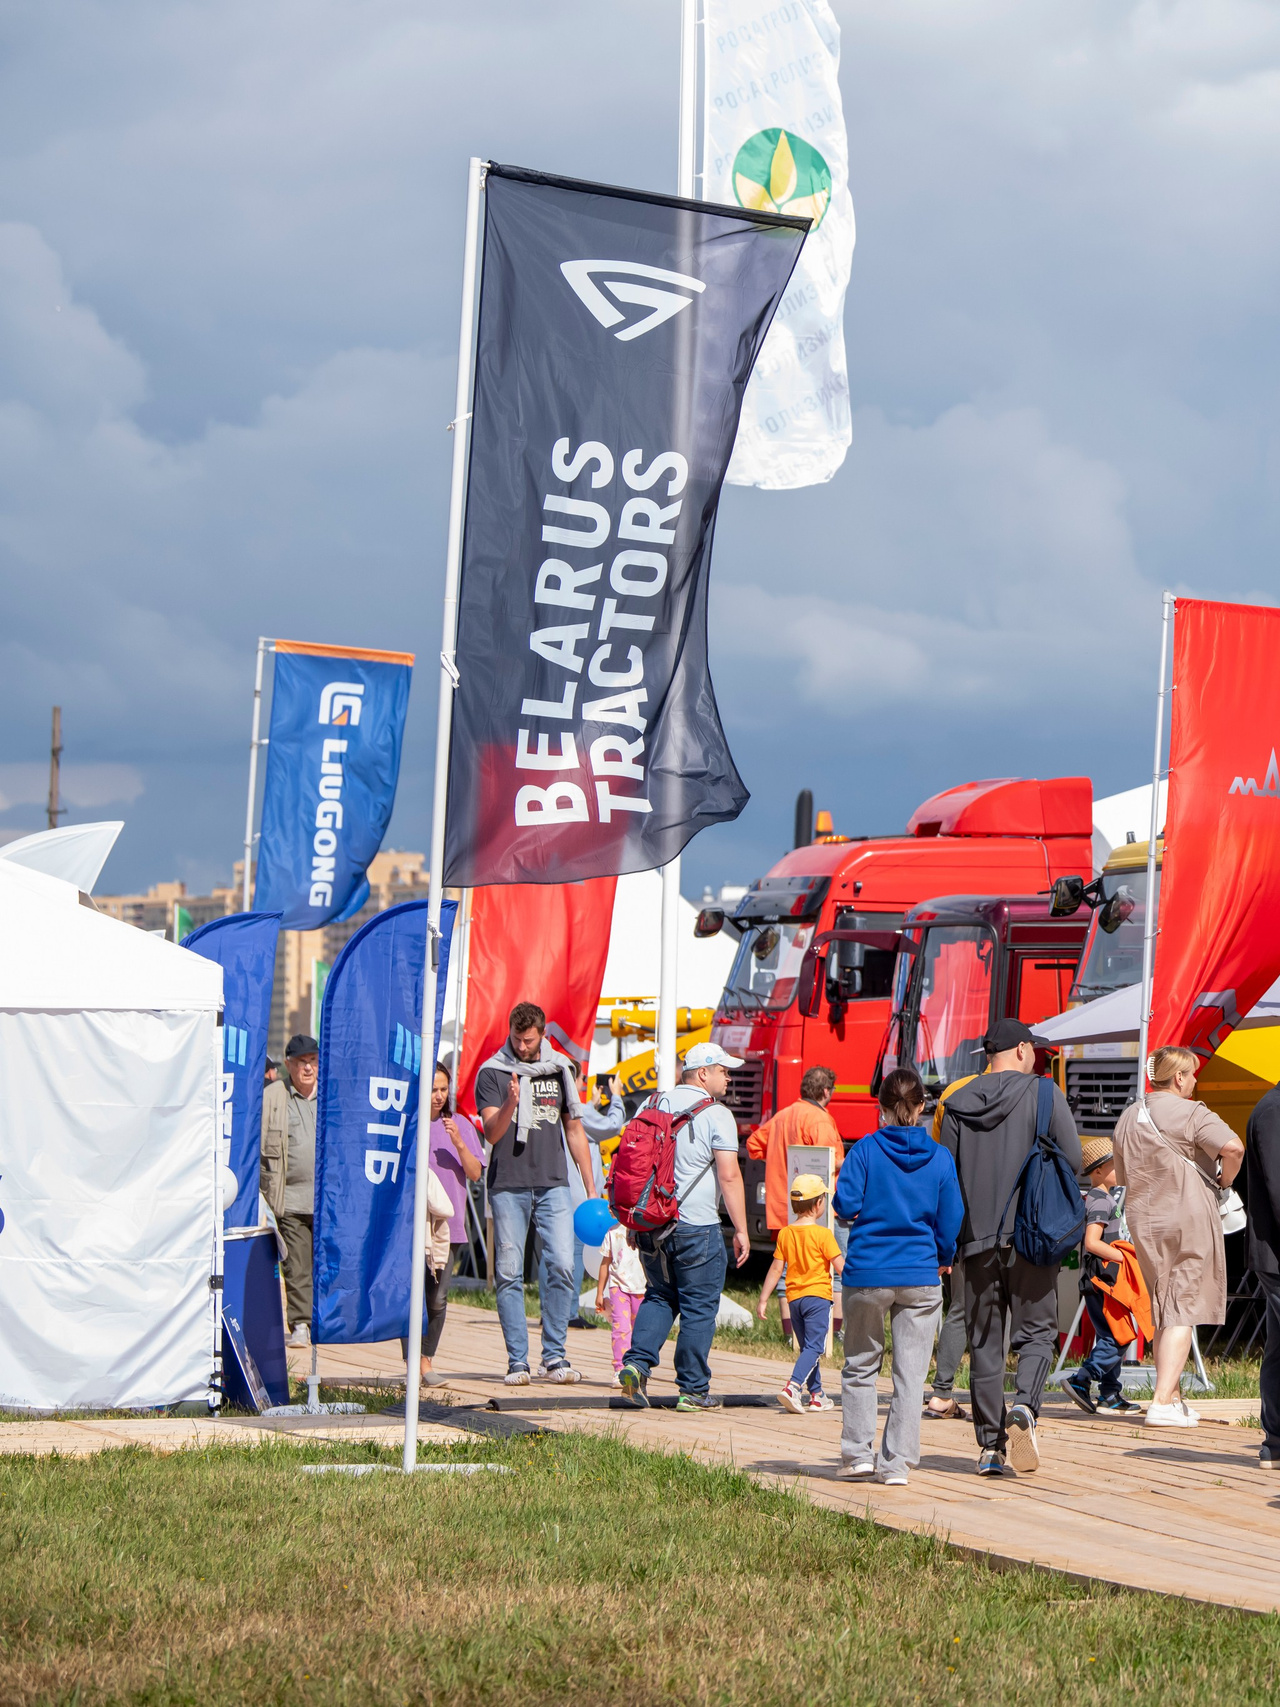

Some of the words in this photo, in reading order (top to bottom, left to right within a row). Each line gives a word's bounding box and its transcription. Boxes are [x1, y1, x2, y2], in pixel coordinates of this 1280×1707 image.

[515, 437, 614, 826] BELARUS
[582, 448, 689, 824] TRACTORS
[364, 1076, 410, 1185] ВТБ
